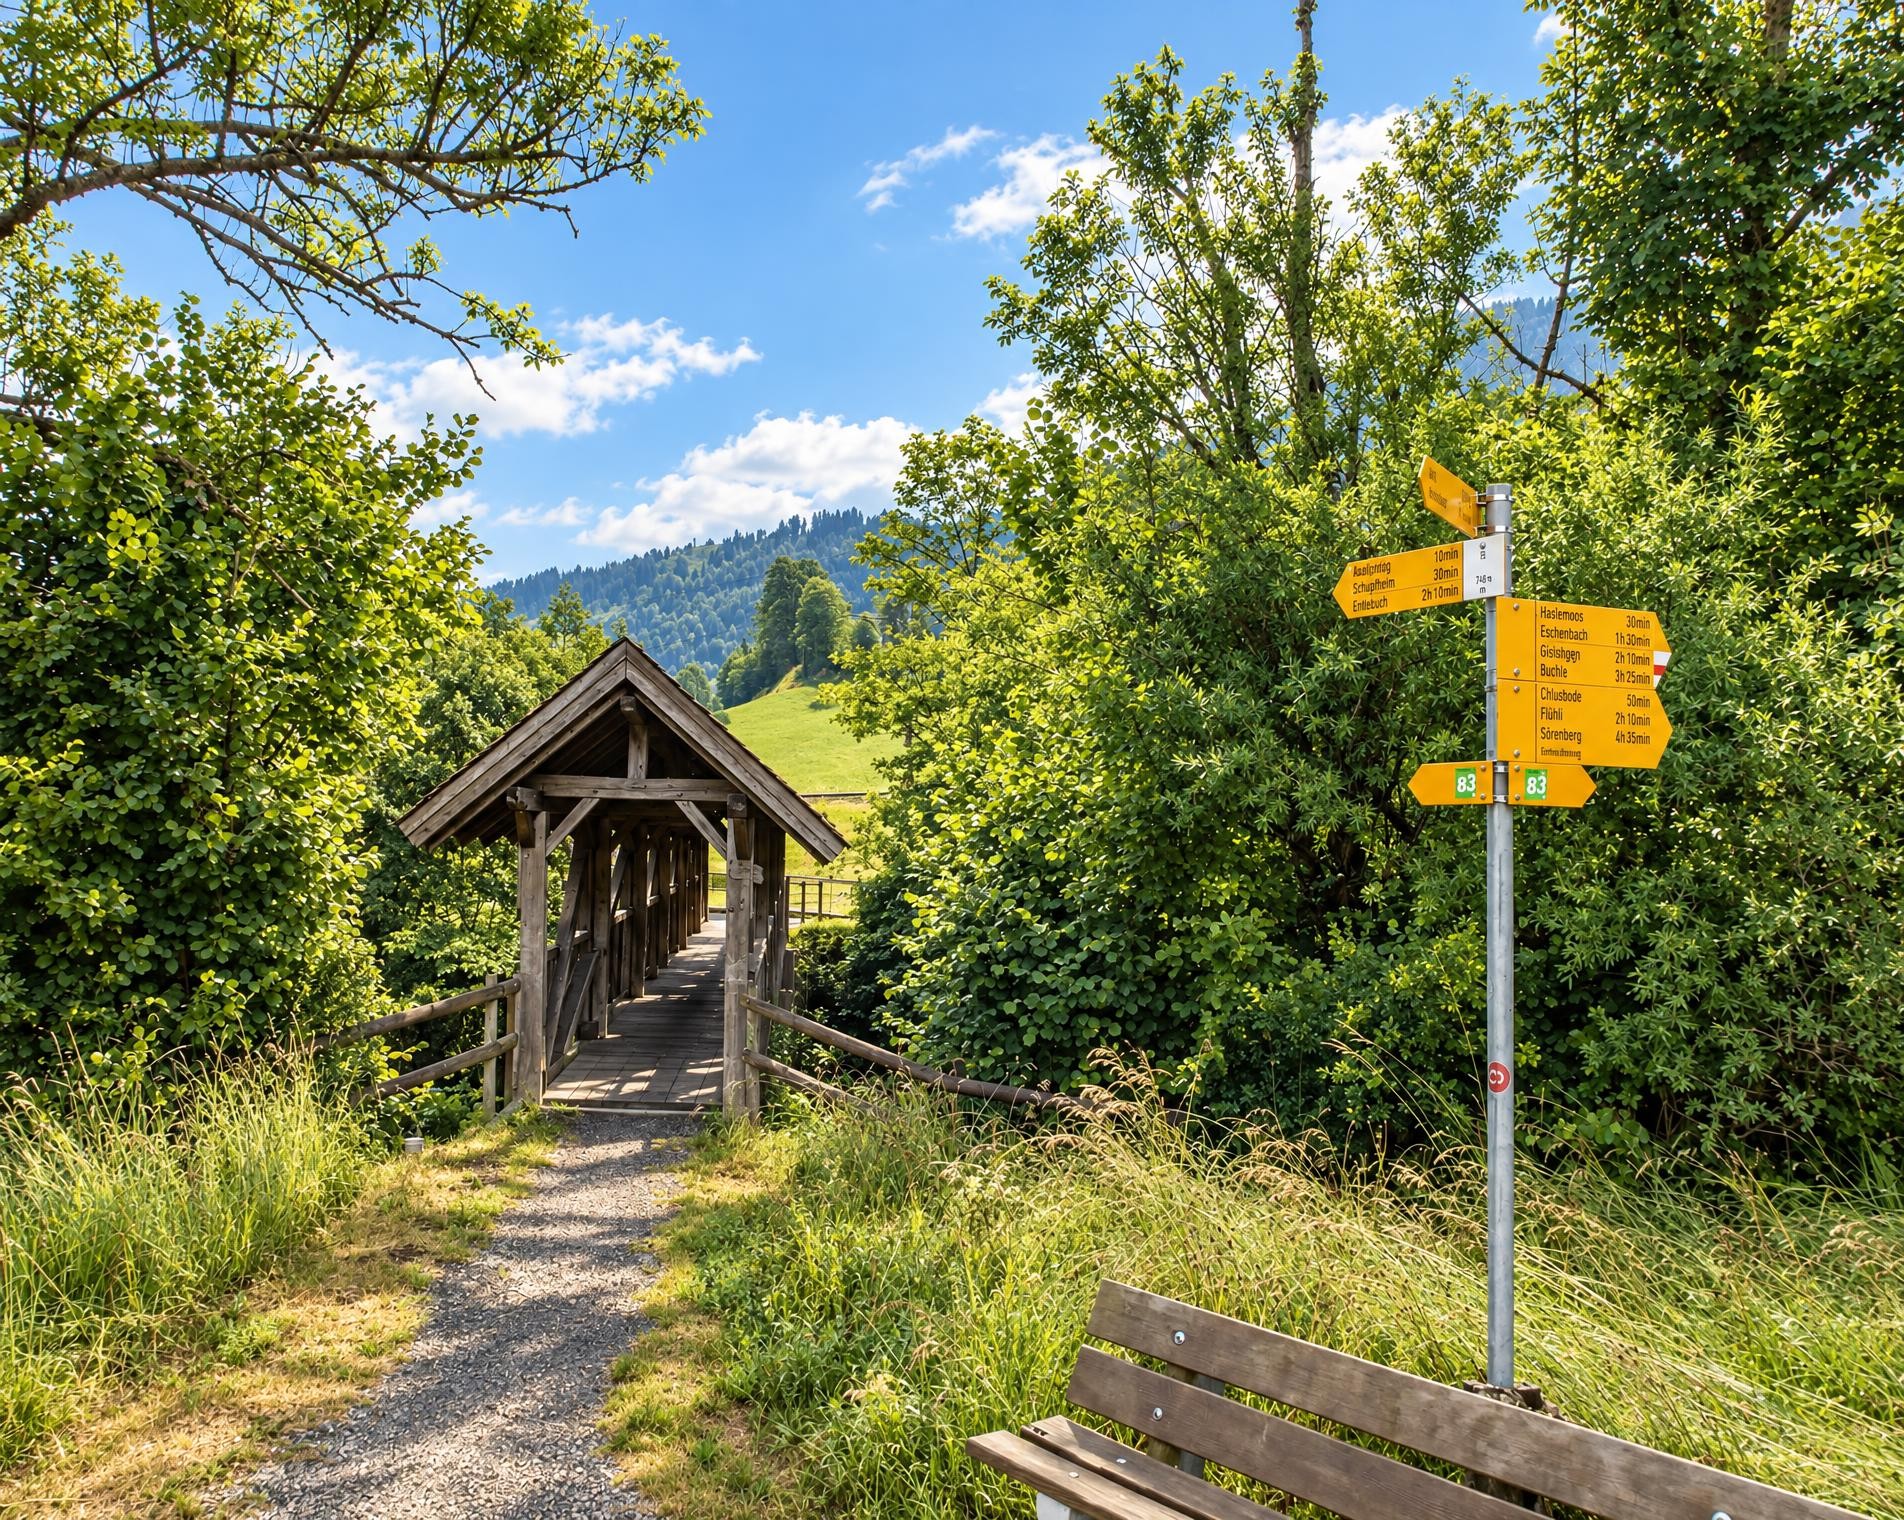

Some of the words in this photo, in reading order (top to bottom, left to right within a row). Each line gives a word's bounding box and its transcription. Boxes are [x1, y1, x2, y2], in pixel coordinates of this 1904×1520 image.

[1434, 549, 1459, 563] 10min
[1433, 566, 1459, 581] 30min
[1422, 588, 1432, 601] 2h
[1434, 584, 1459, 599] 10min
[1540, 606, 1584, 622] Haslemoos
[1626, 615, 1650, 629] 30min
[1540, 625, 1588, 641] Eschenbach
[1615, 632, 1625, 645] 1h
[1626, 634, 1650, 647] 30min
[1615, 652, 1625, 664] 2h
[1627, 653, 1650, 666] 10min
[1615, 670, 1625, 682] 3h
[1626, 671, 1650, 685] 25min
[1627, 694, 1650, 708] 50min
[1615, 712, 1625, 725] 2h
[1627, 713, 1650, 726] 10min
[1540, 727, 1582, 744] Sörenberg
[1615, 731, 1625, 744] 4h
[1626, 732, 1650, 745] 35min
[1457, 773, 1476, 793] 83
[1527, 775, 1547, 795] 83
